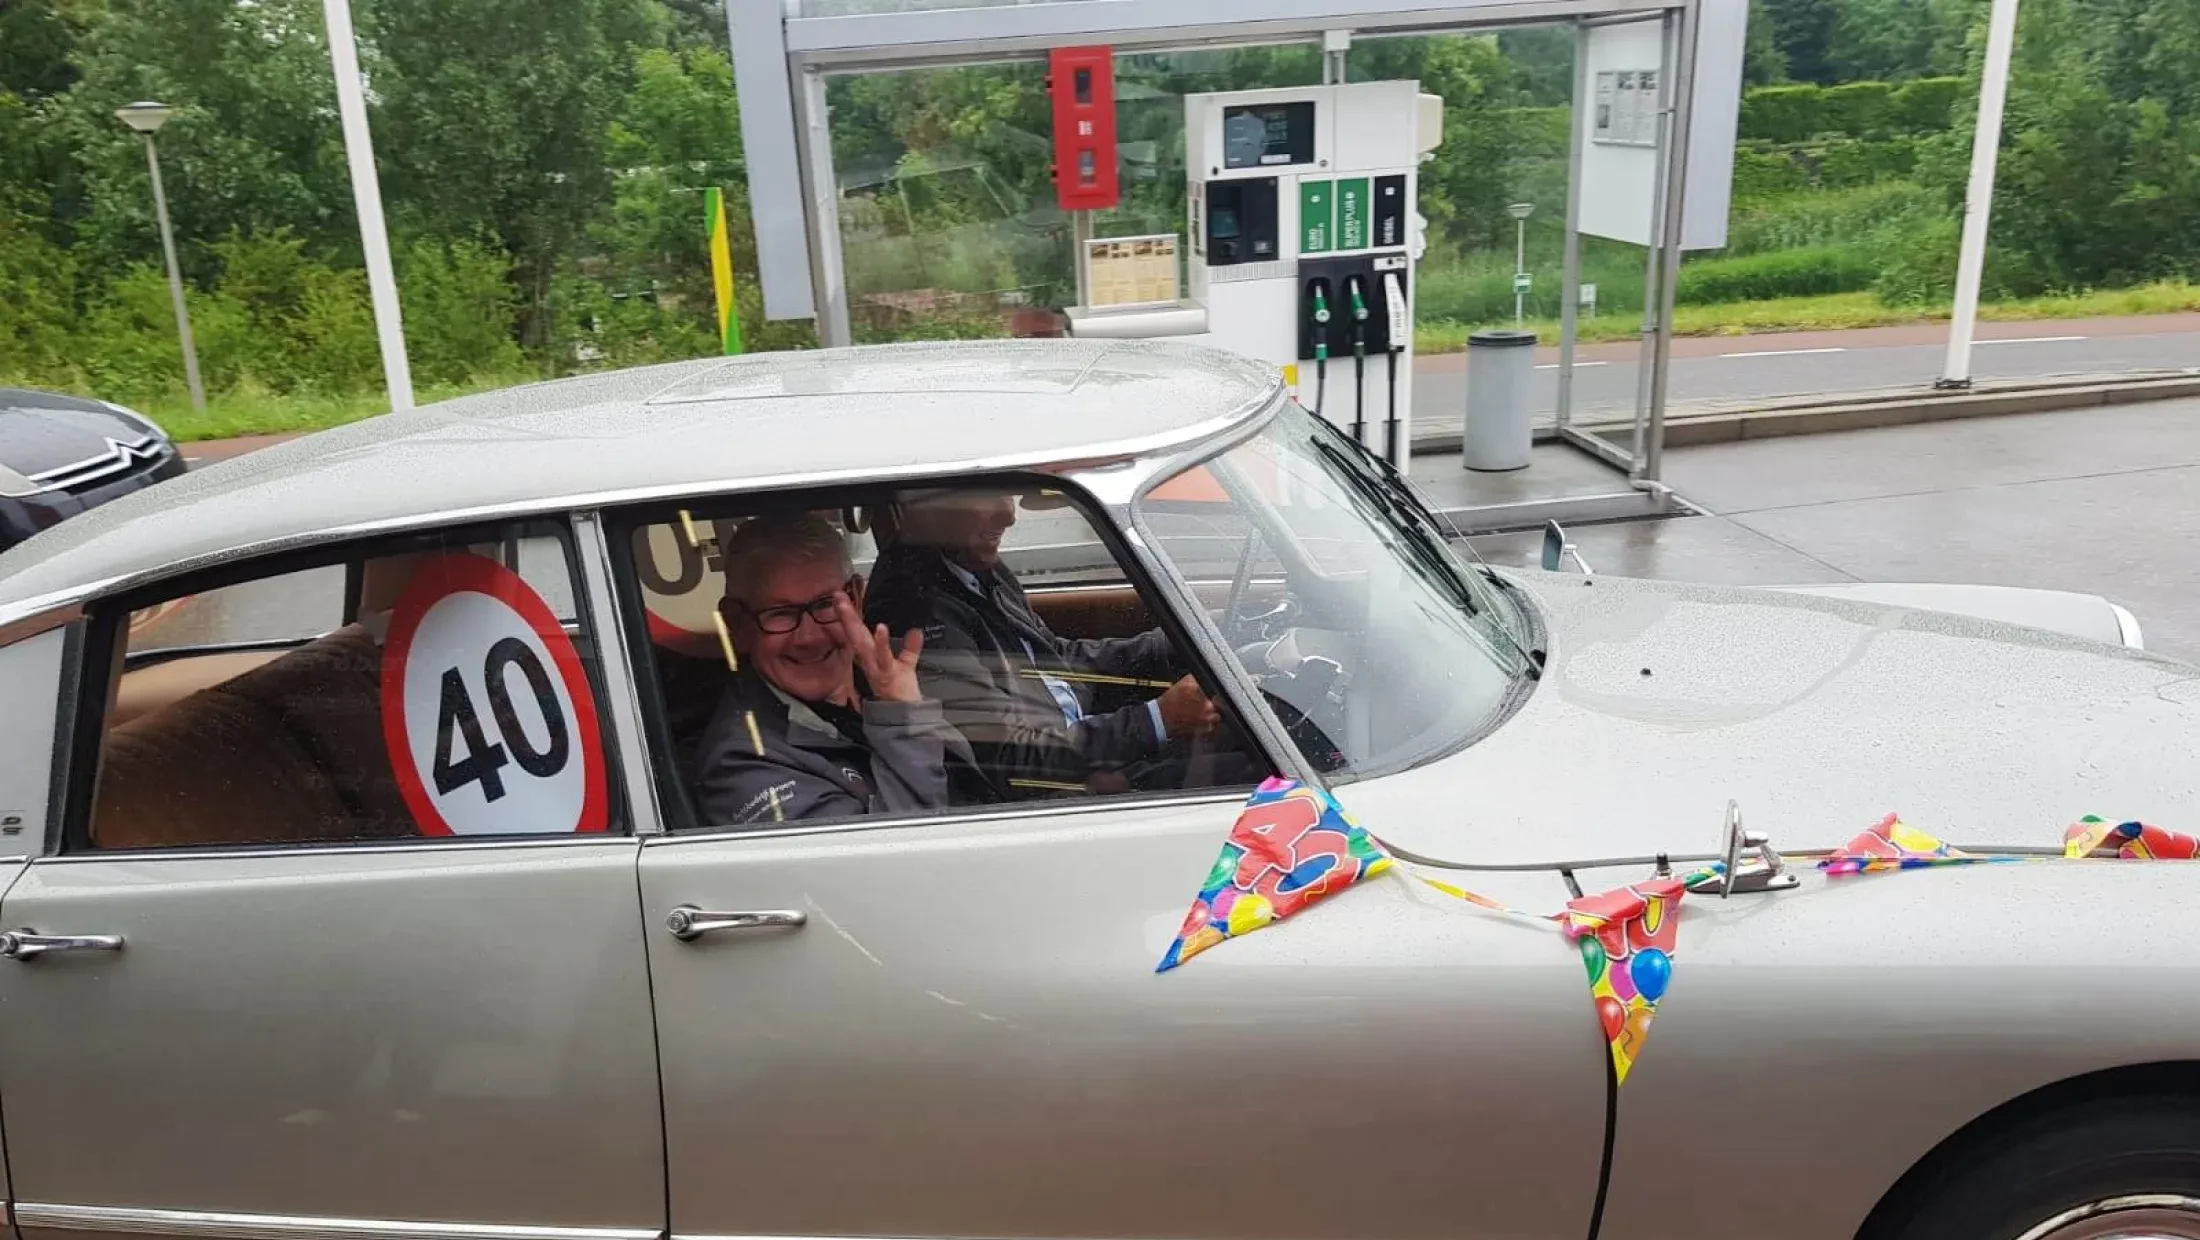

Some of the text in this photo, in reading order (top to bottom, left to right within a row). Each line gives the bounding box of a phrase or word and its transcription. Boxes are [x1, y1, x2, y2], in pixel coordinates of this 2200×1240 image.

[1383, 216, 1394, 244] DIESEL
[433, 636, 569, 803] 40
[1226, 797, 1361, 918] 40
